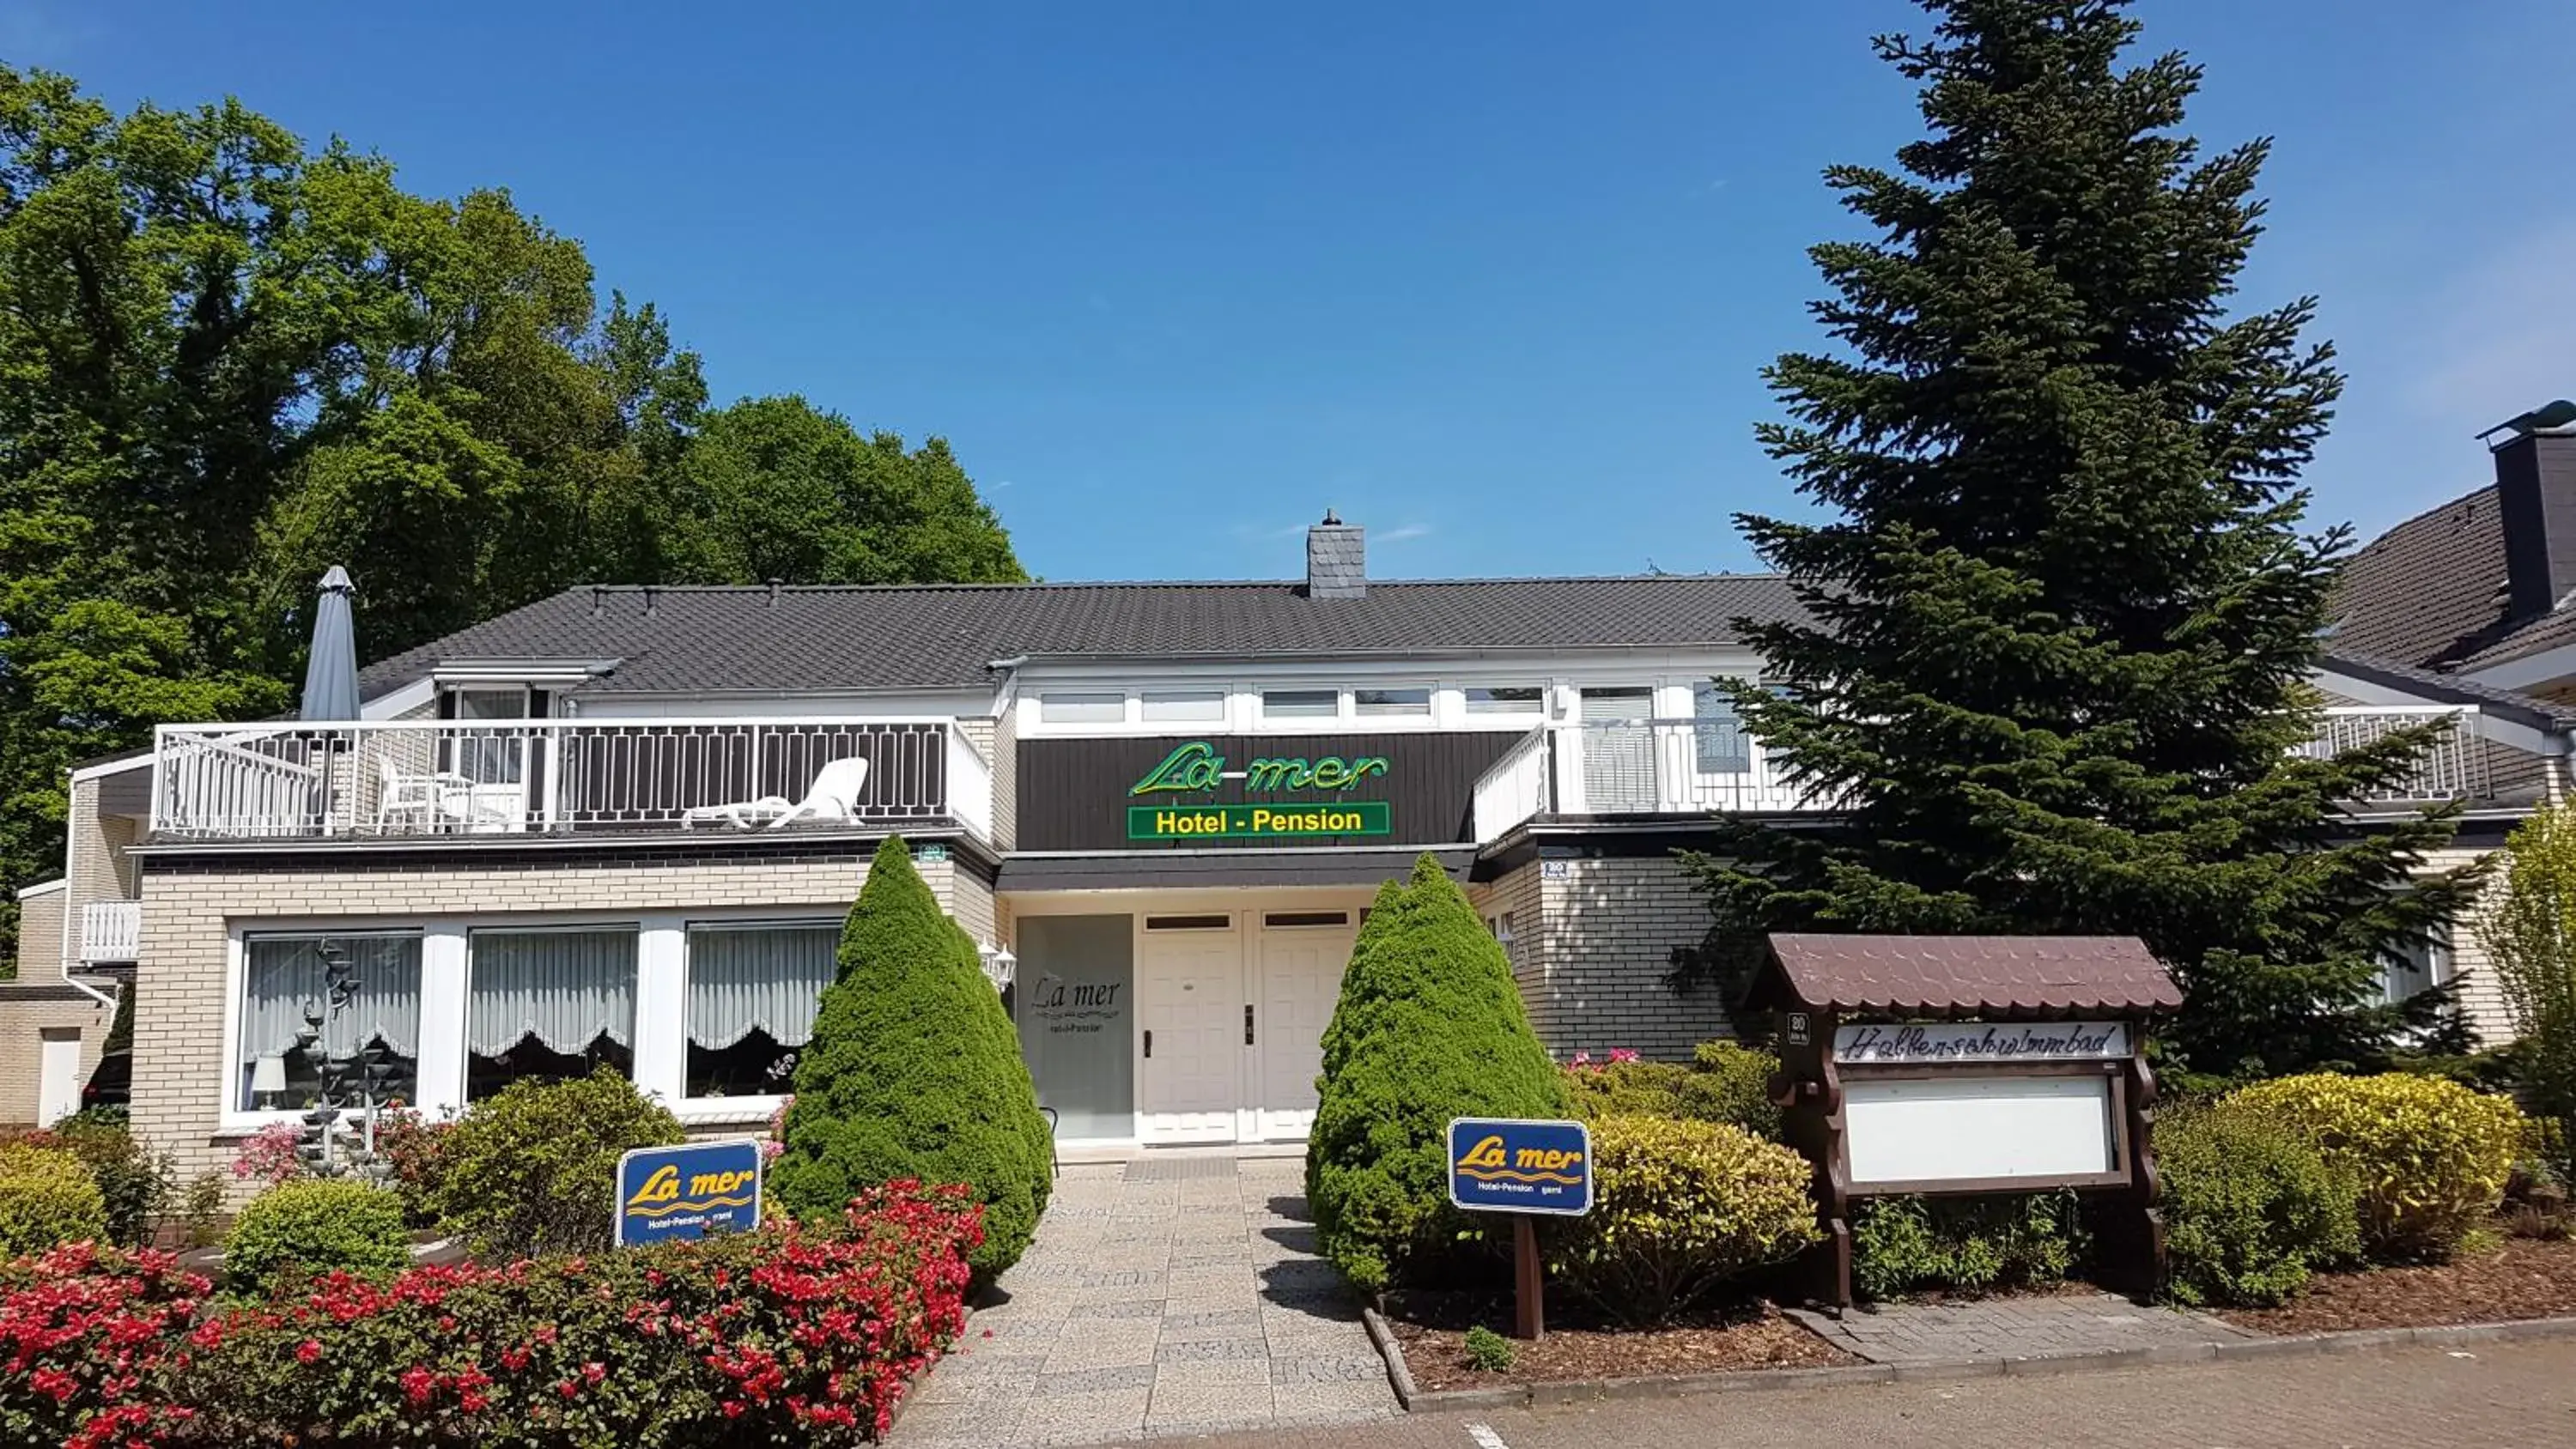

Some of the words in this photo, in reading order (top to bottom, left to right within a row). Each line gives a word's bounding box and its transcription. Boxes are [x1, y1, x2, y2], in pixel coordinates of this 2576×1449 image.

[1127, 742, 1225, 797] La
[1246, 756, 1388, 791] mer
[1156, 811, 1226, 834] Hotel
[1252, 809, 1362, 832] Pension
[1031, 977, 1066, 1008] La
[1072, 982, 1121, 1007] mer
[1456, 1135, 1507, 1167] La
[1515, 1148, 1583, 1169] mer
[626, 1165, 681, 1205] La
[689, 1170, 755, 1197] mer
[1478, 1180, 1534, 1194] Hotel-Pension
[648, 1214, 705, 1230] Hotel-Pension
